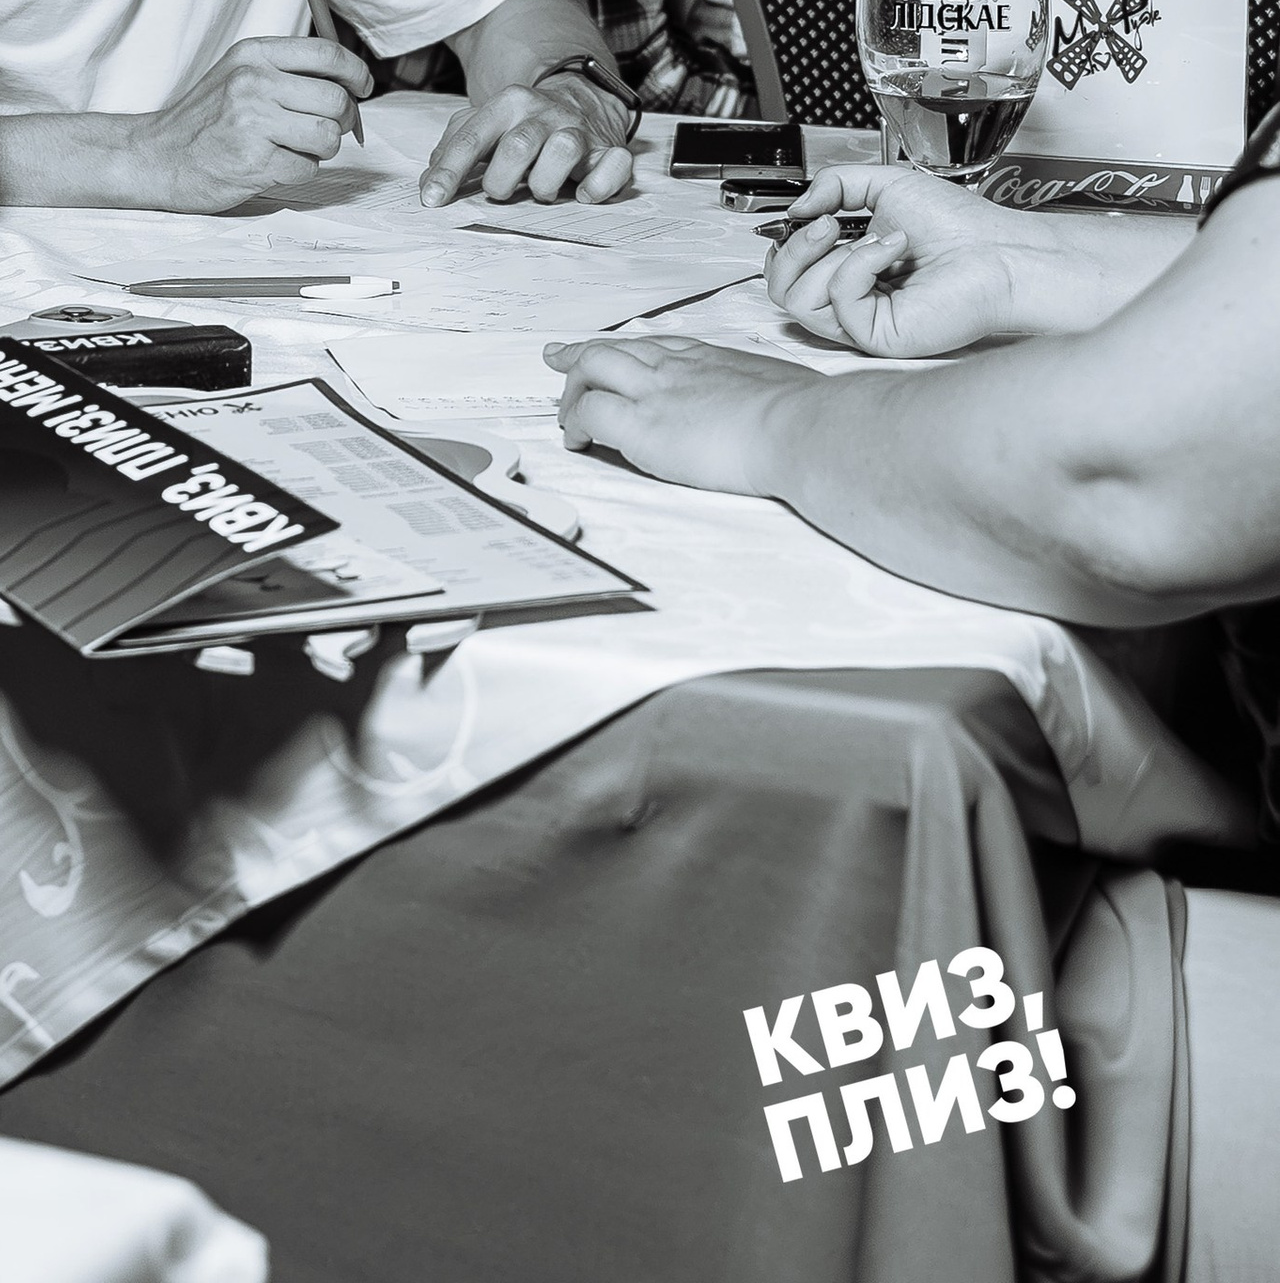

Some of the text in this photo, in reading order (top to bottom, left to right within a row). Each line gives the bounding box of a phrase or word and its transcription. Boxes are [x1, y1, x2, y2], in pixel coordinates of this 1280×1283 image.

[890, 2, 1011, 34] ЛІДСКАЕ
[42, 404, 189, 482] ПЛИЗ!
[162, 462, 305, 553] КВИЗ,
